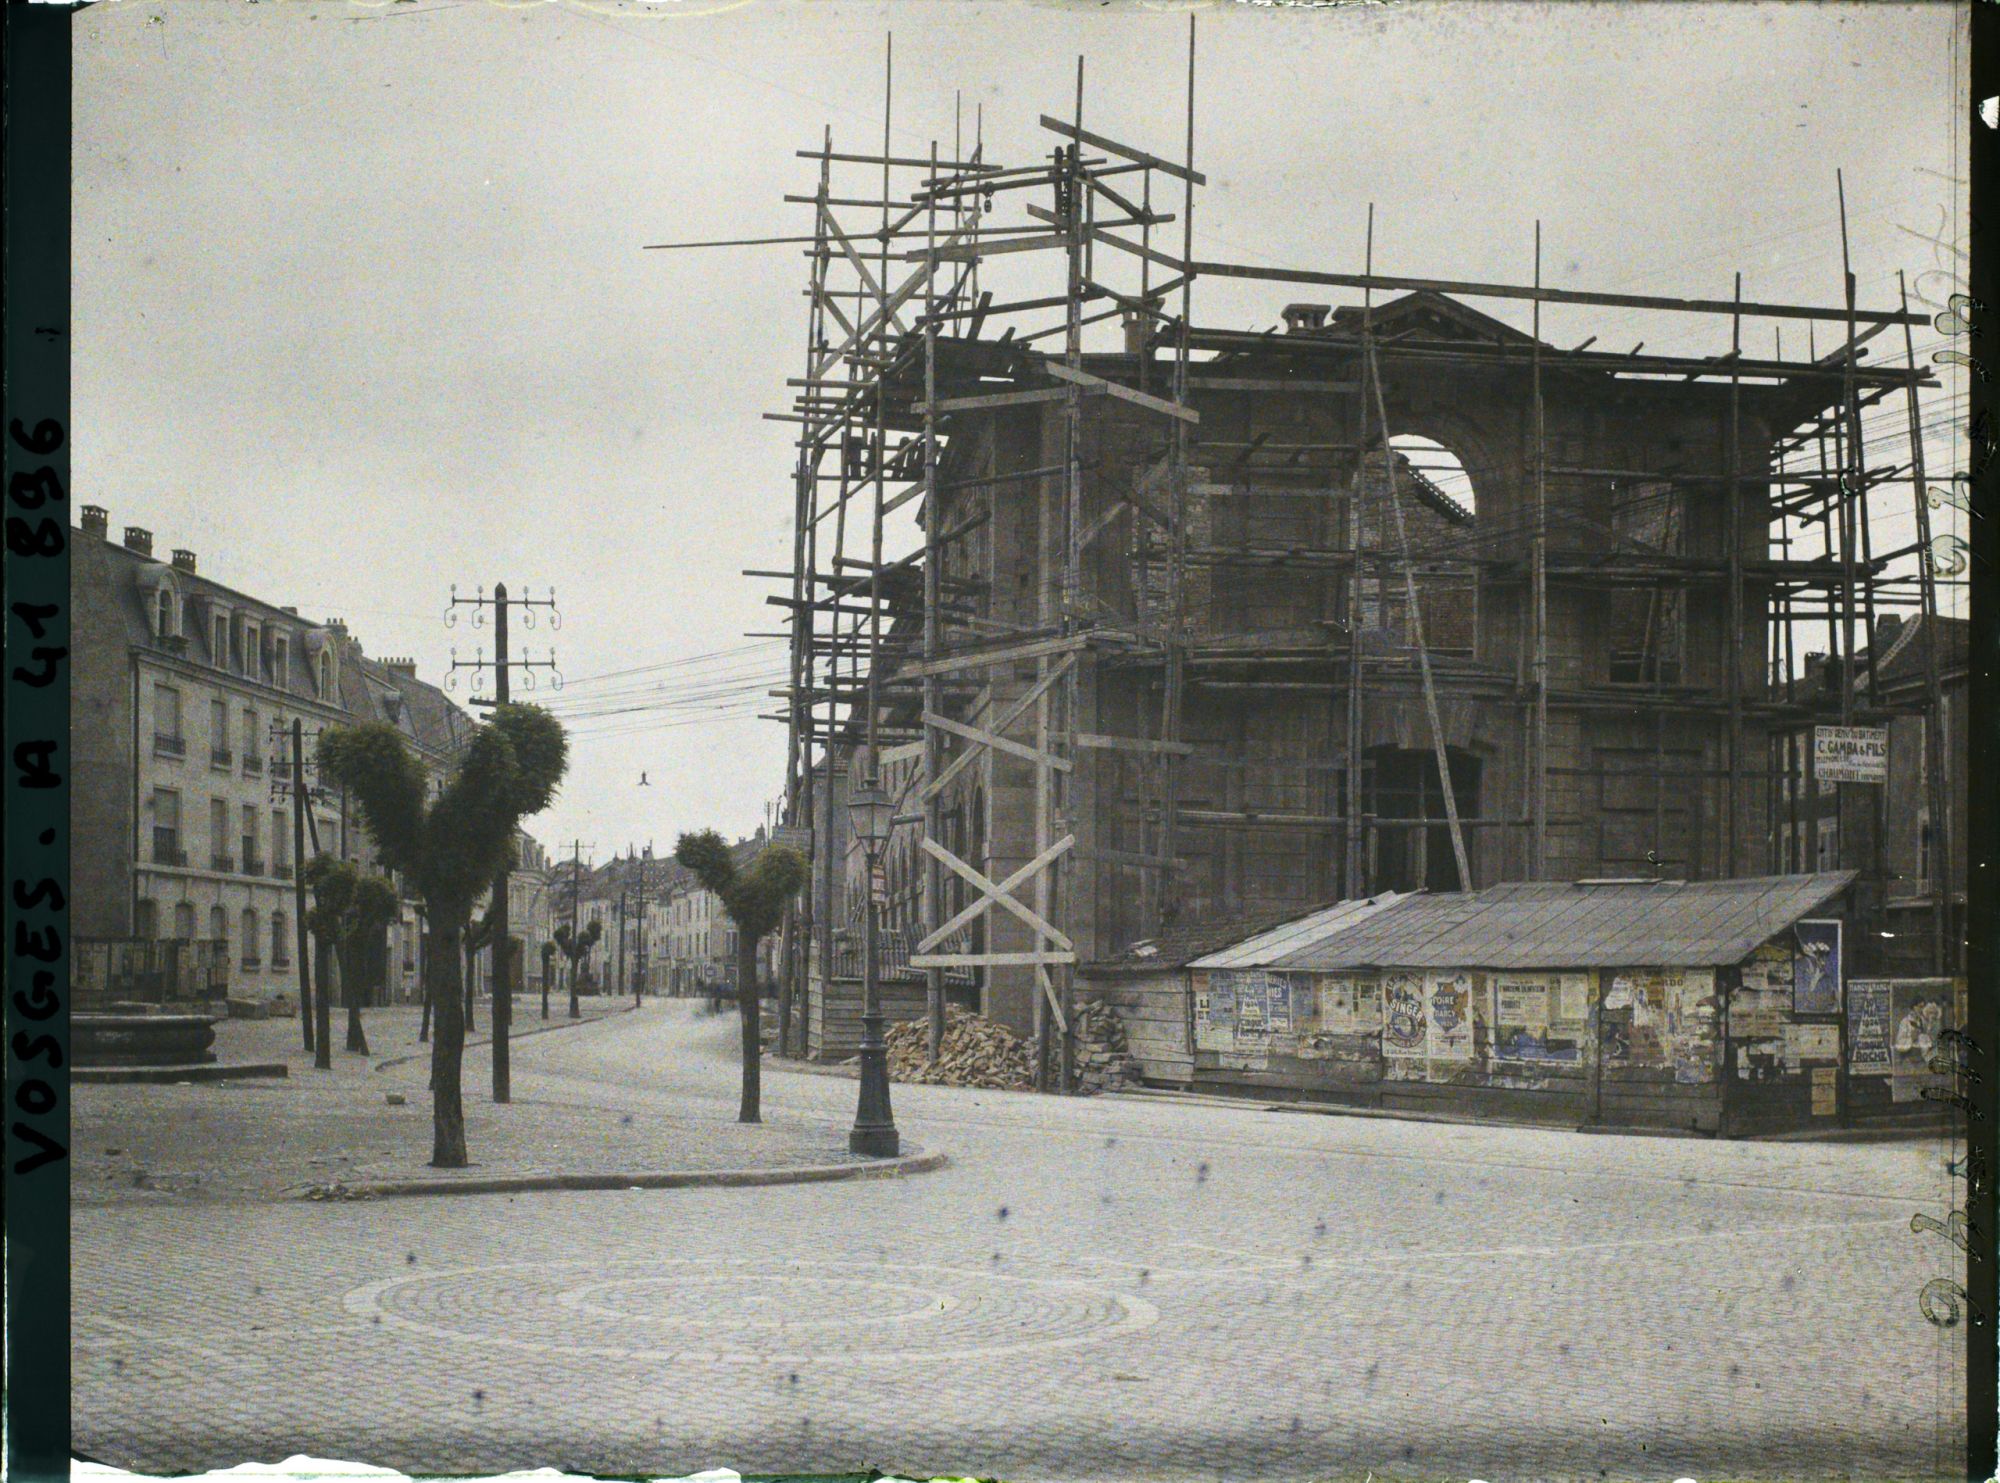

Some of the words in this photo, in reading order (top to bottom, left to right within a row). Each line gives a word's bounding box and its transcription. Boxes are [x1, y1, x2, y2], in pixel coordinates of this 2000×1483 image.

[1828, 740, 1858, 756] GAMBA
[1866, 742, 1886, 757] FILS
[1390, 999, 1424, 1022] SINGER
